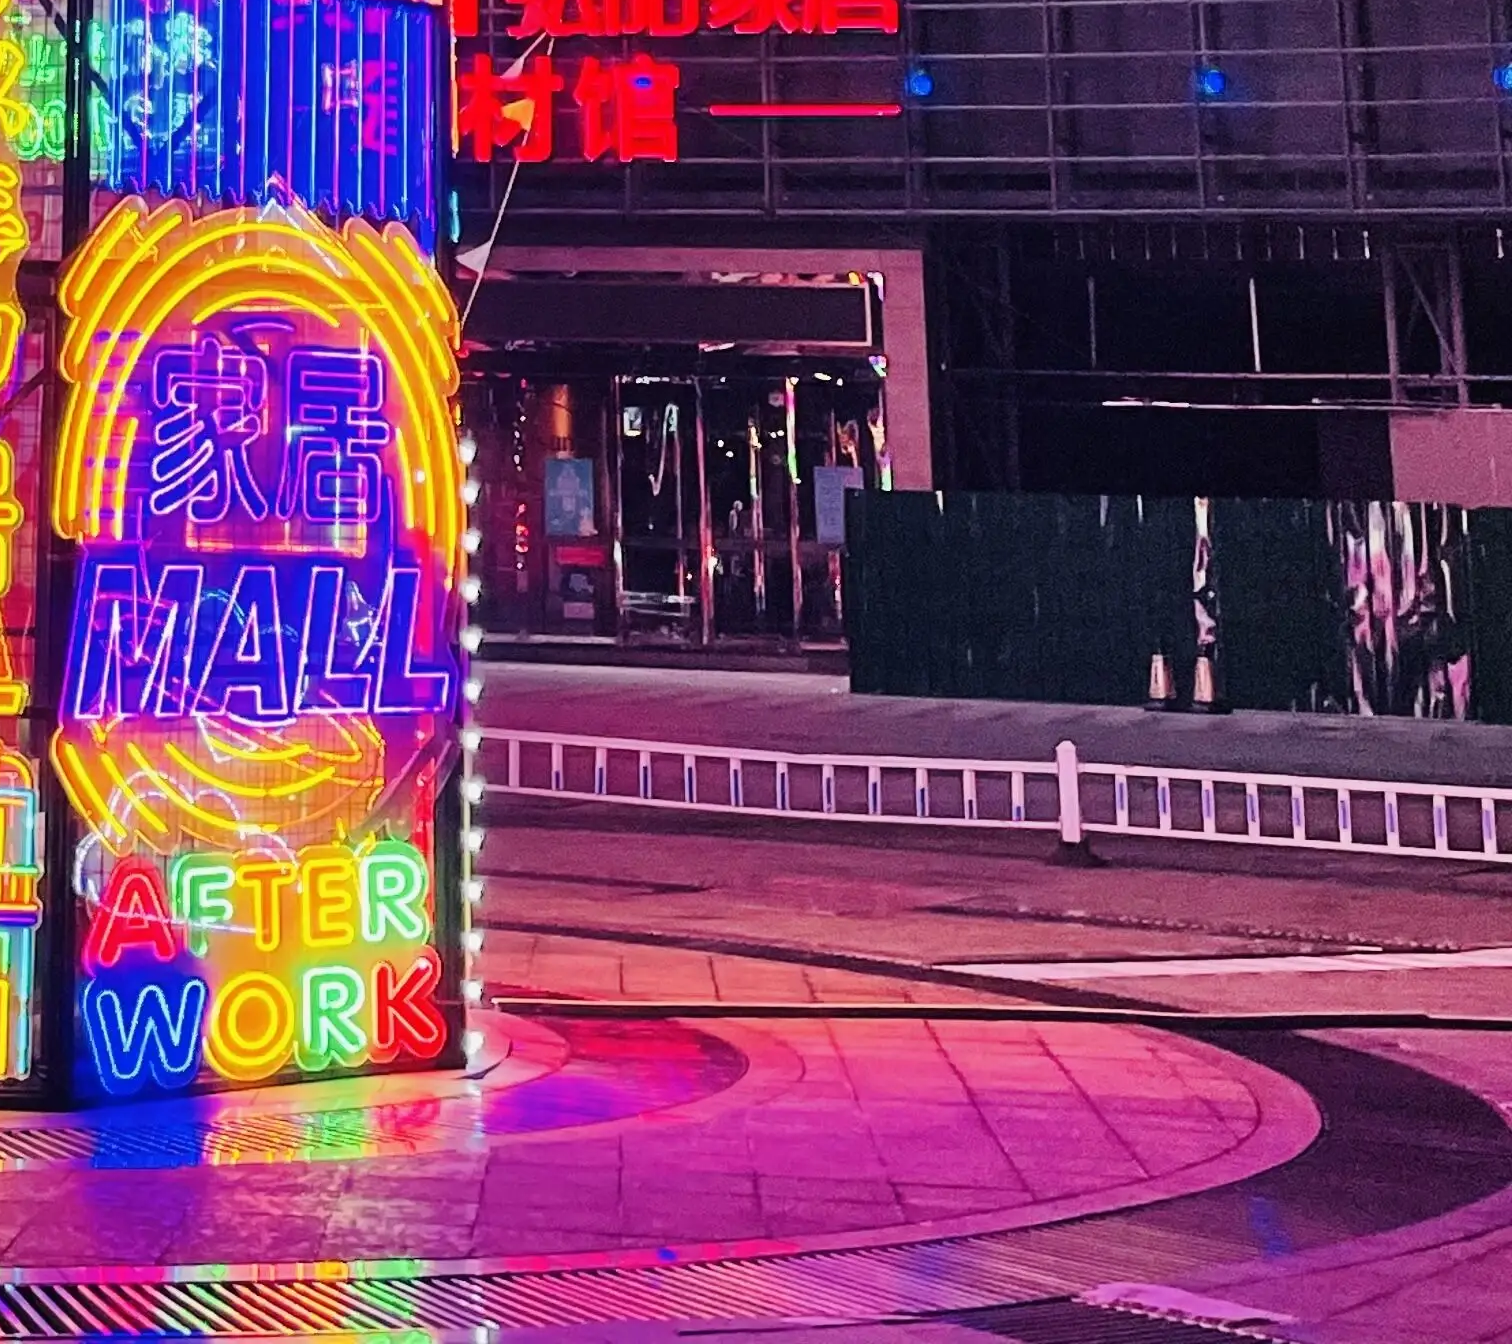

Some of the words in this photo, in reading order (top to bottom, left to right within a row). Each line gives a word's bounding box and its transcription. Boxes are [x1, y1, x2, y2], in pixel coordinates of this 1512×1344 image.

[148, 334, 393, 524] 家居
[74, 564, 451, 721] MALL
[88, 842, 428, 968] AFTER
[88, 954, 444, 1082] WORK
